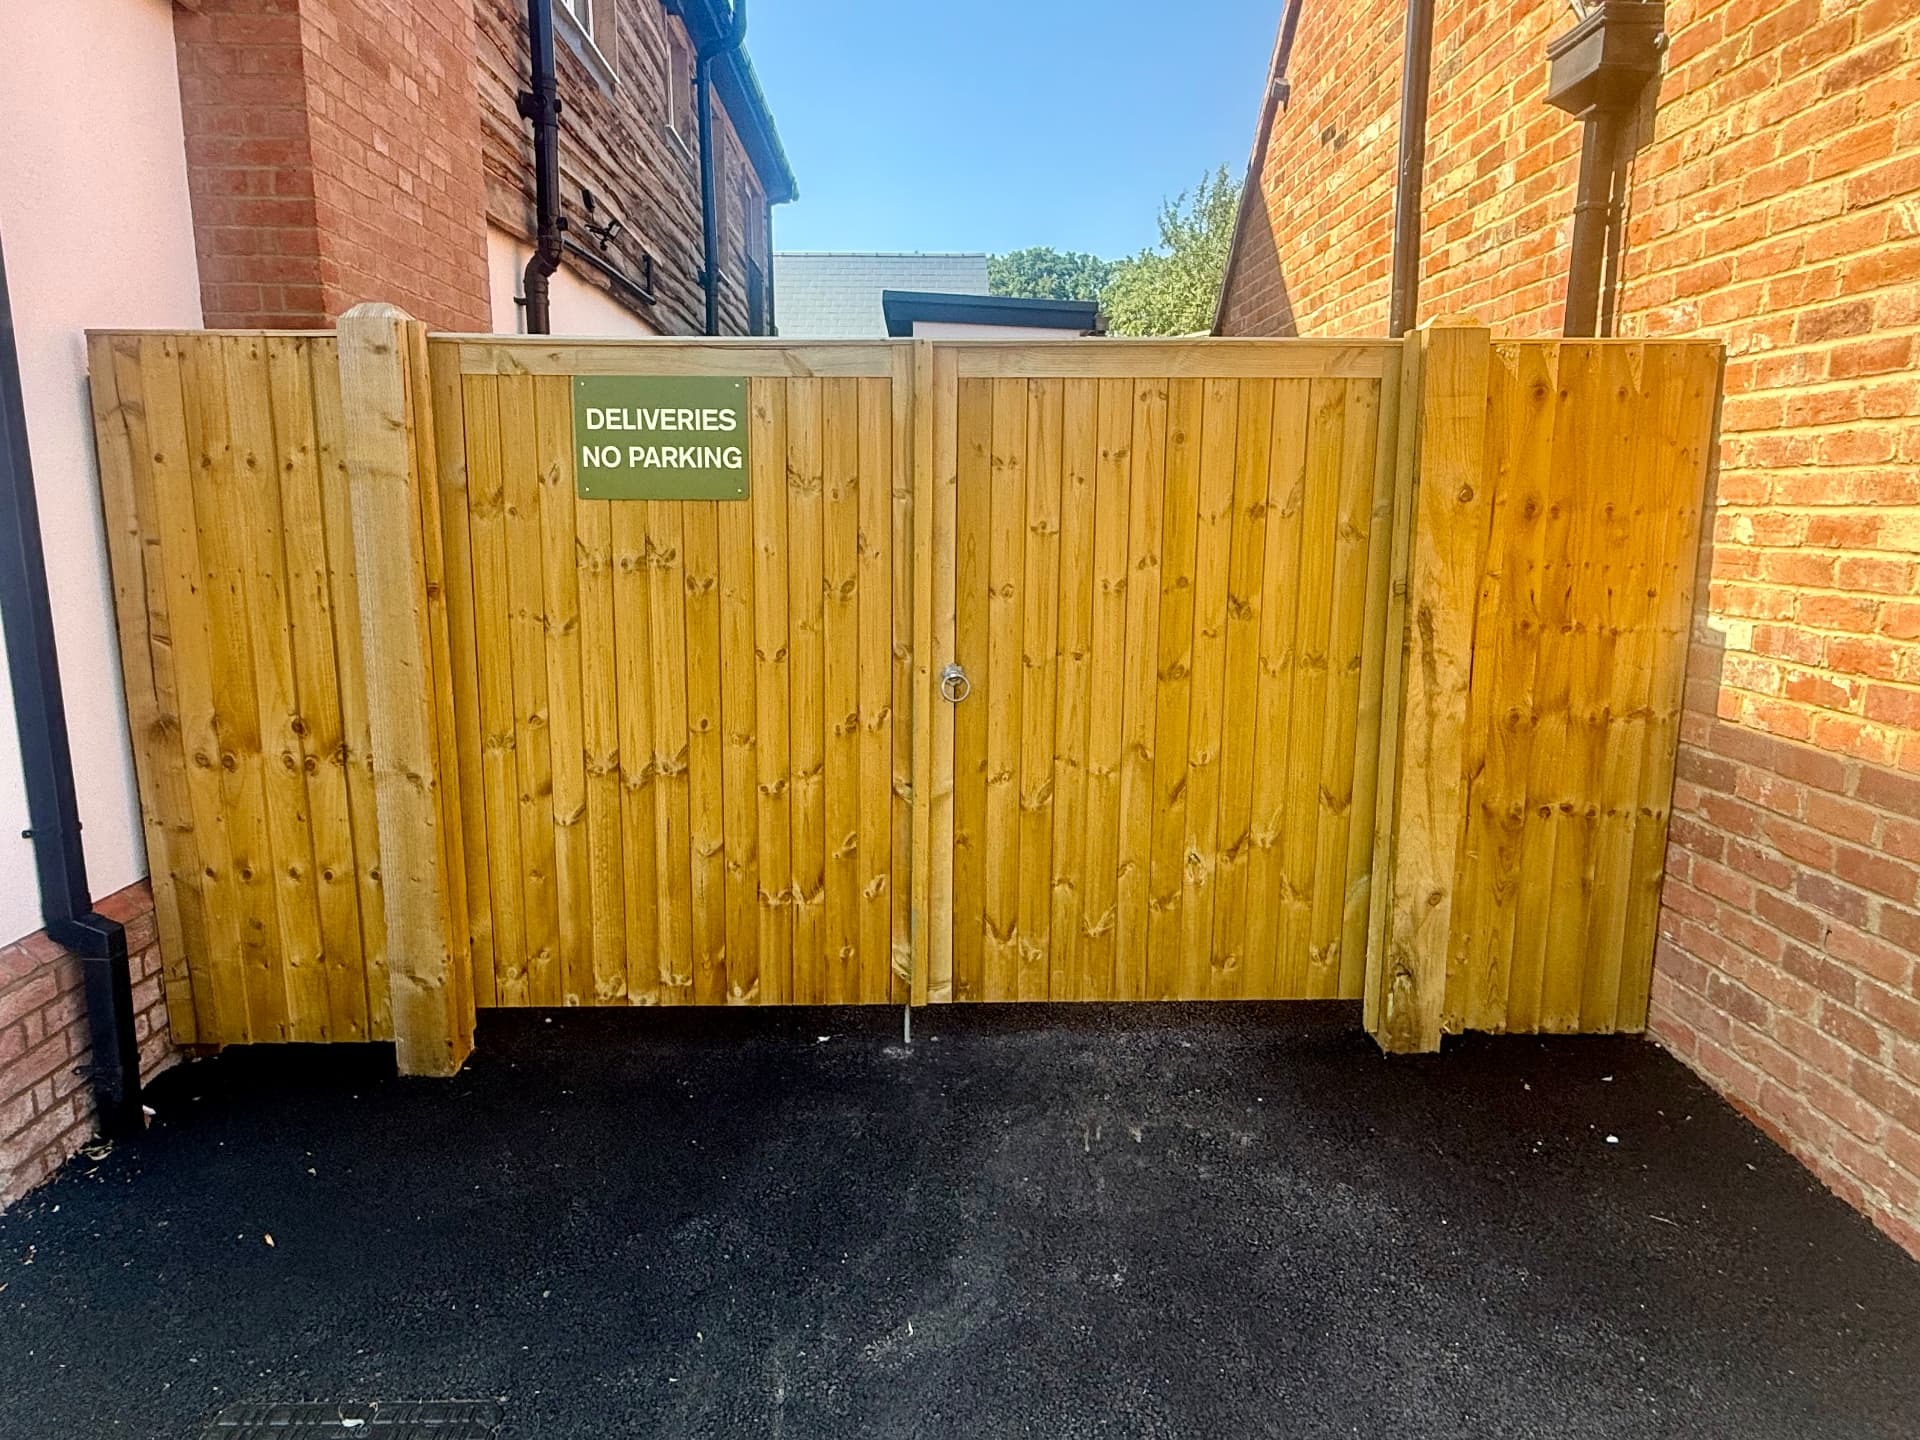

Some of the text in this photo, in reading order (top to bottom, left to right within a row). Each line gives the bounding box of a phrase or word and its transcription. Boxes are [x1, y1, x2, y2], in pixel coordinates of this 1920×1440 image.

[586, 408, 737, 431] DELIVERIES
[582, 446, 742, 469] NO PARKING
